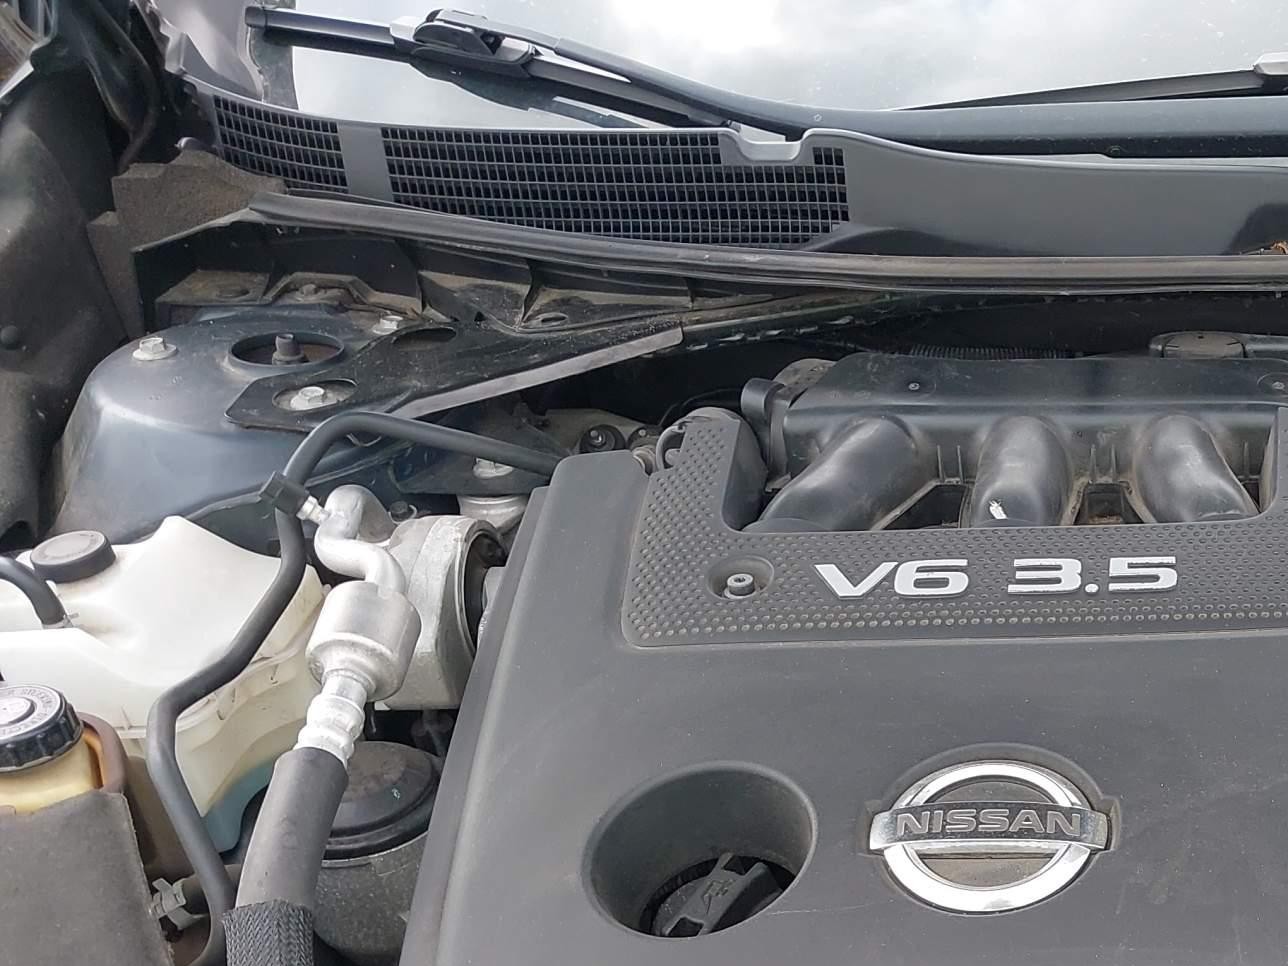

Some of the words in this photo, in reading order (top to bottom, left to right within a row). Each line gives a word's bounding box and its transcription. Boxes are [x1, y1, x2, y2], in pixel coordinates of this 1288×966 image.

[814, 559, 970, 598] V6
[1007, 556, 1178, 595] 3.5
[896, 809, 1081, 836] NISSAN
